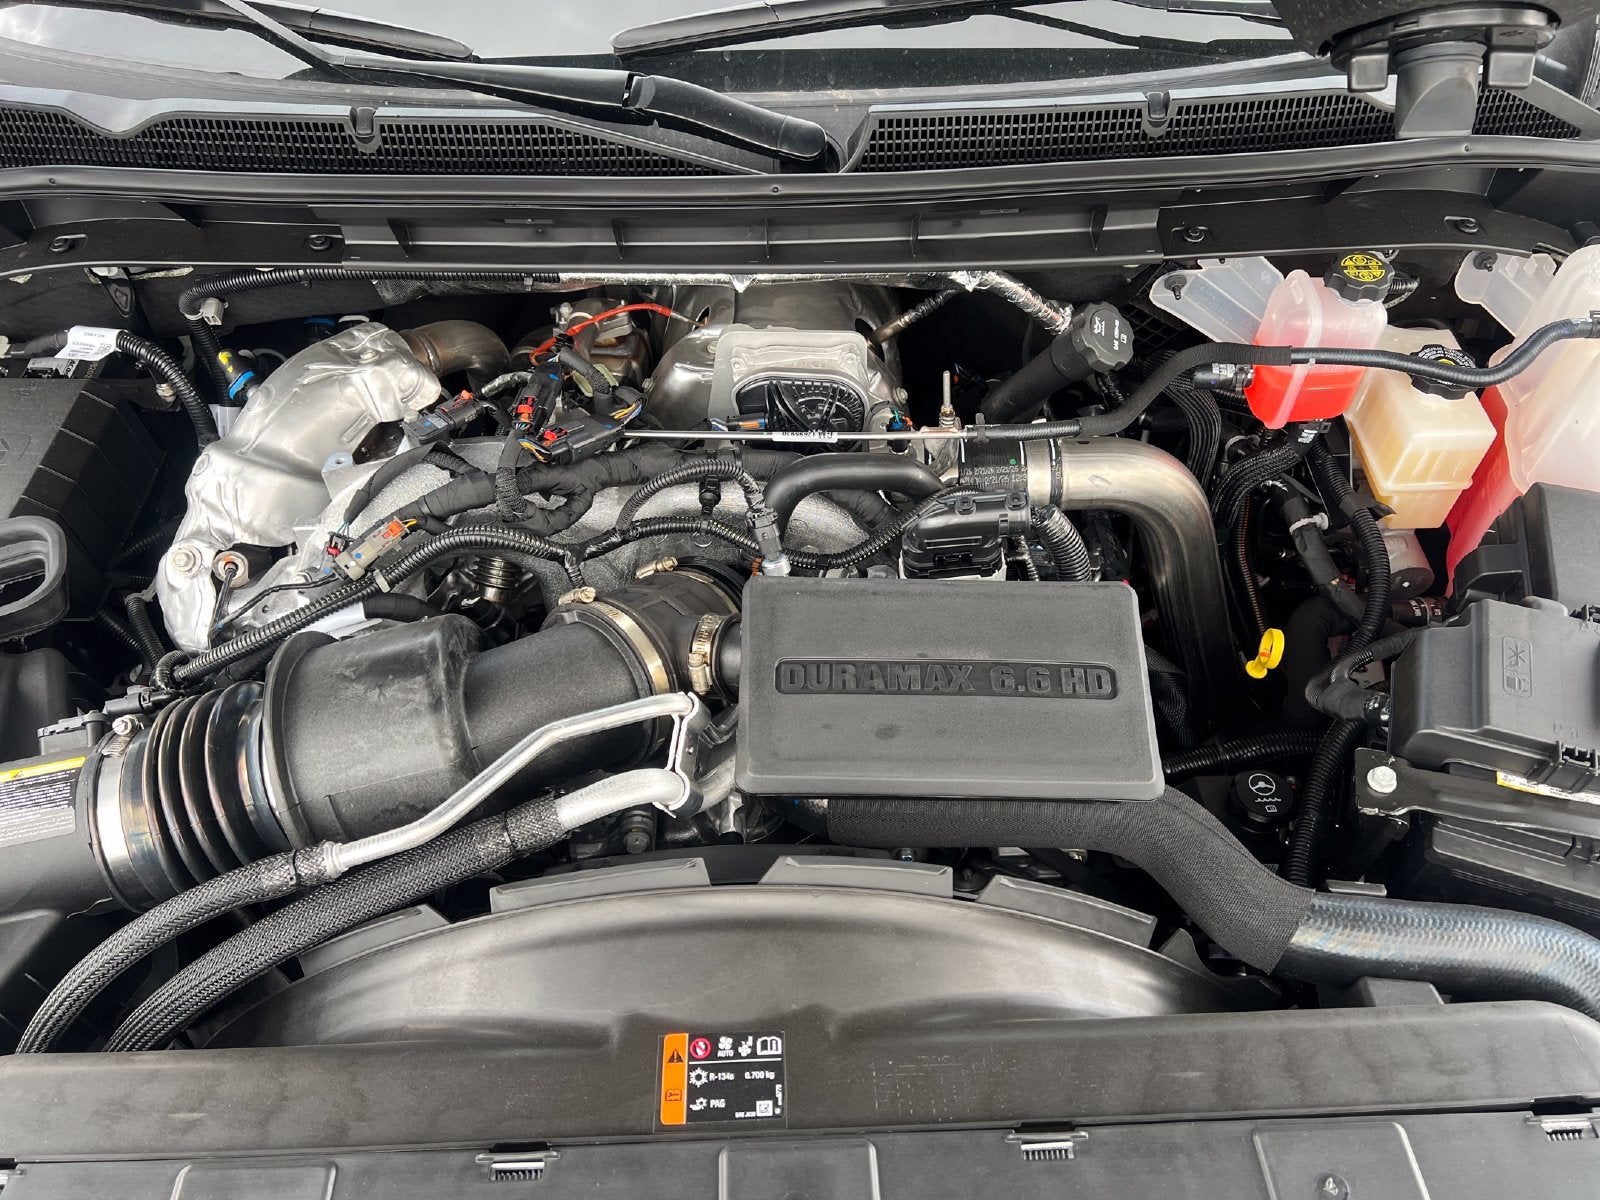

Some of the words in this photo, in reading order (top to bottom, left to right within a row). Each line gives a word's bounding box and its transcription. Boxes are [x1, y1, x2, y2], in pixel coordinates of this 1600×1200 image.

[780, 663, 975, 692] DURAMAX
[990, 665, 1051, 694] 6.6
[1060, 667, 1113, 695] HD
[709, 1072, 734, 1081] R-134a
[744, 1071, 764, 1080] 0.700
[765, 1071, 775, 1080] kg
[710, 1099, 725, 1108] PAG
